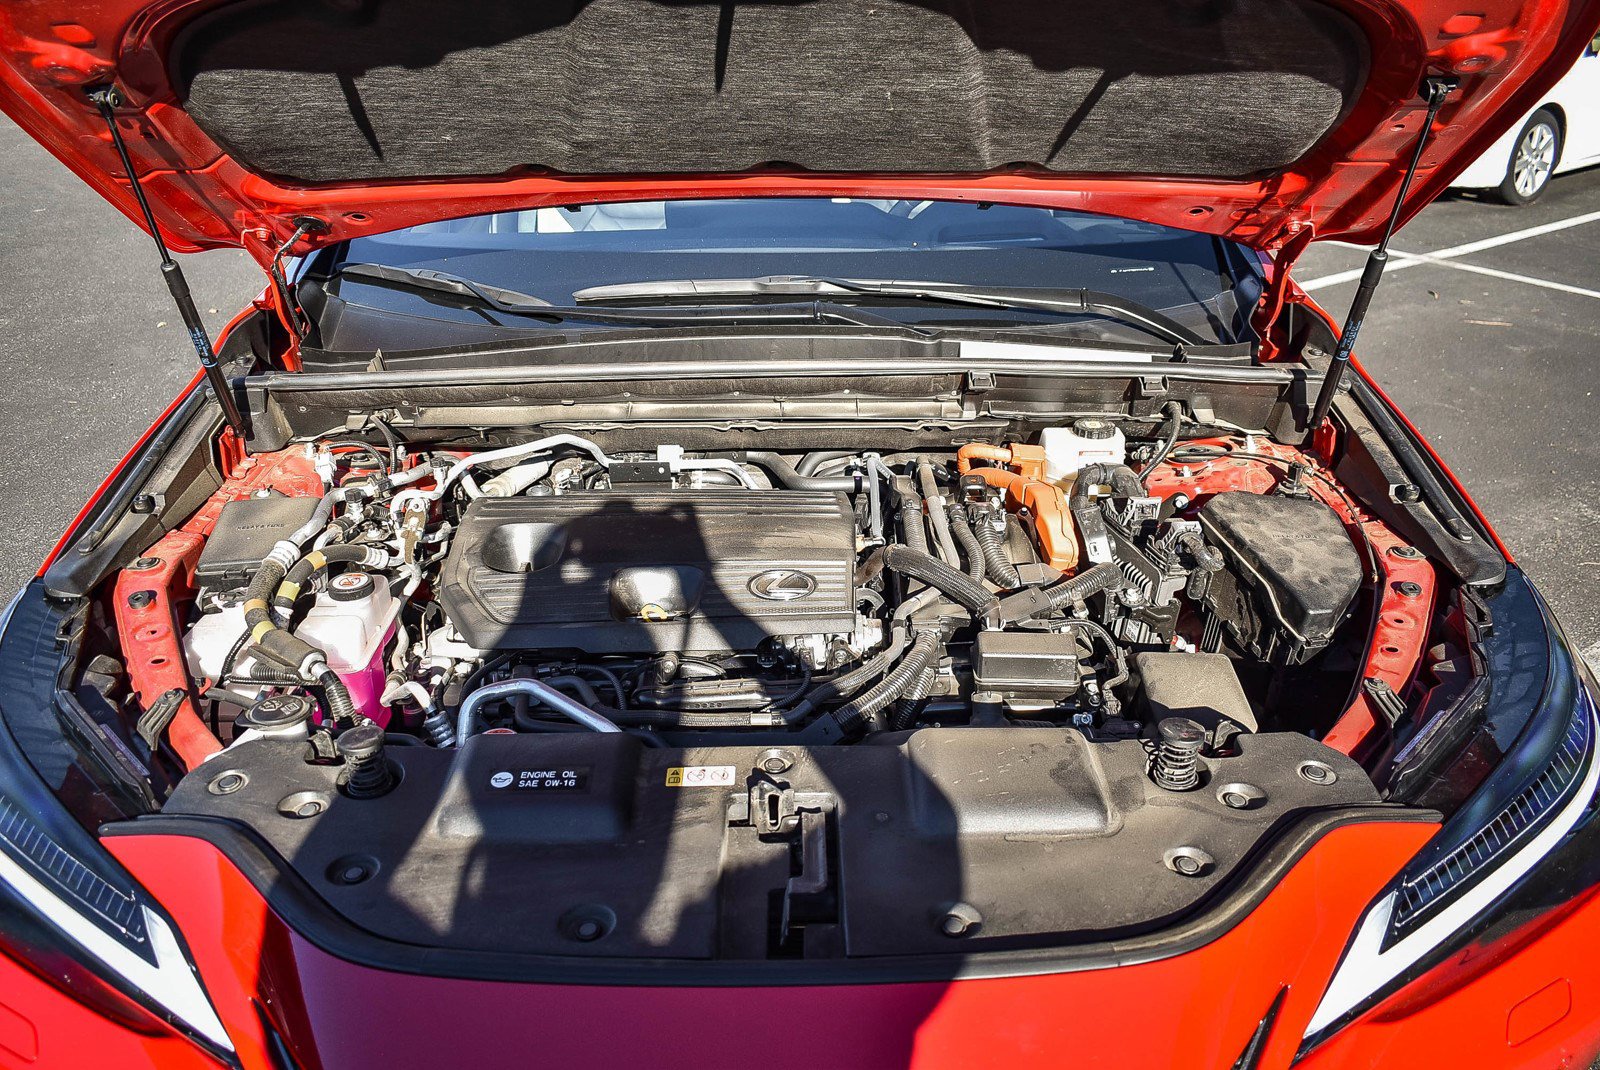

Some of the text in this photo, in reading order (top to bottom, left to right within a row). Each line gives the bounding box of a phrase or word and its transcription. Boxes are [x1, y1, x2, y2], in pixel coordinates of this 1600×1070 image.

[520, 770, 577, 779] ENGINE OIL
[518, 779, 576, 788] SAE 0W-16
